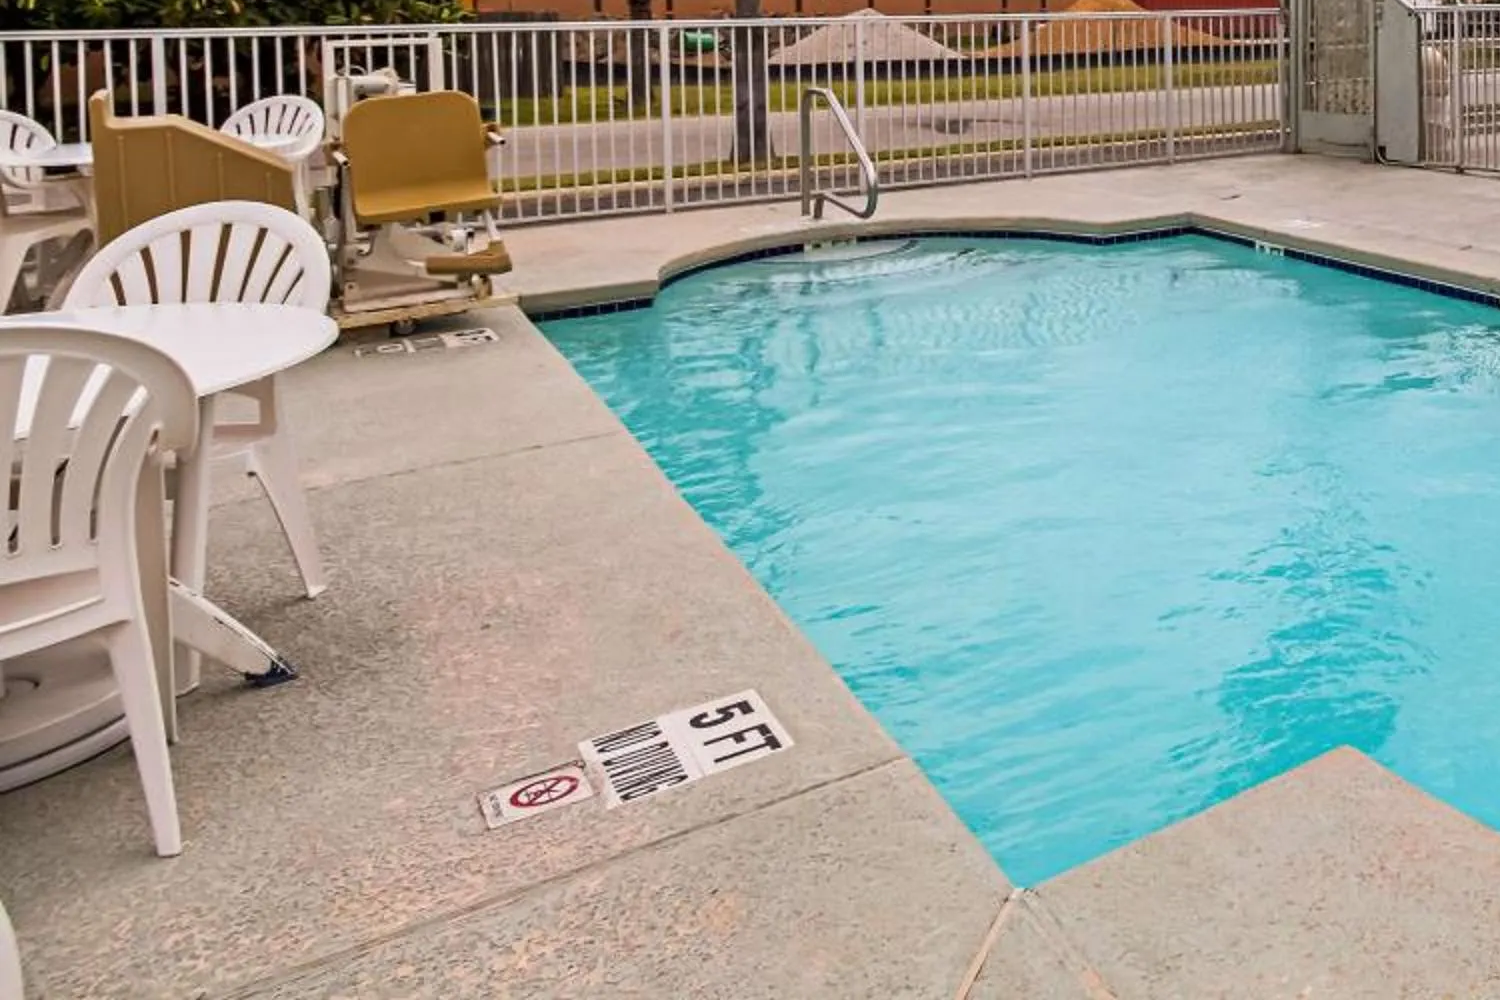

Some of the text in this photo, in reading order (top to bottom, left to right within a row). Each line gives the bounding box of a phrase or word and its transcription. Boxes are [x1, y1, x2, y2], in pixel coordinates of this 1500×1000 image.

[591, 721, 689, 800] NO DIVING
[690, 699, 782, 764] 5 FT
